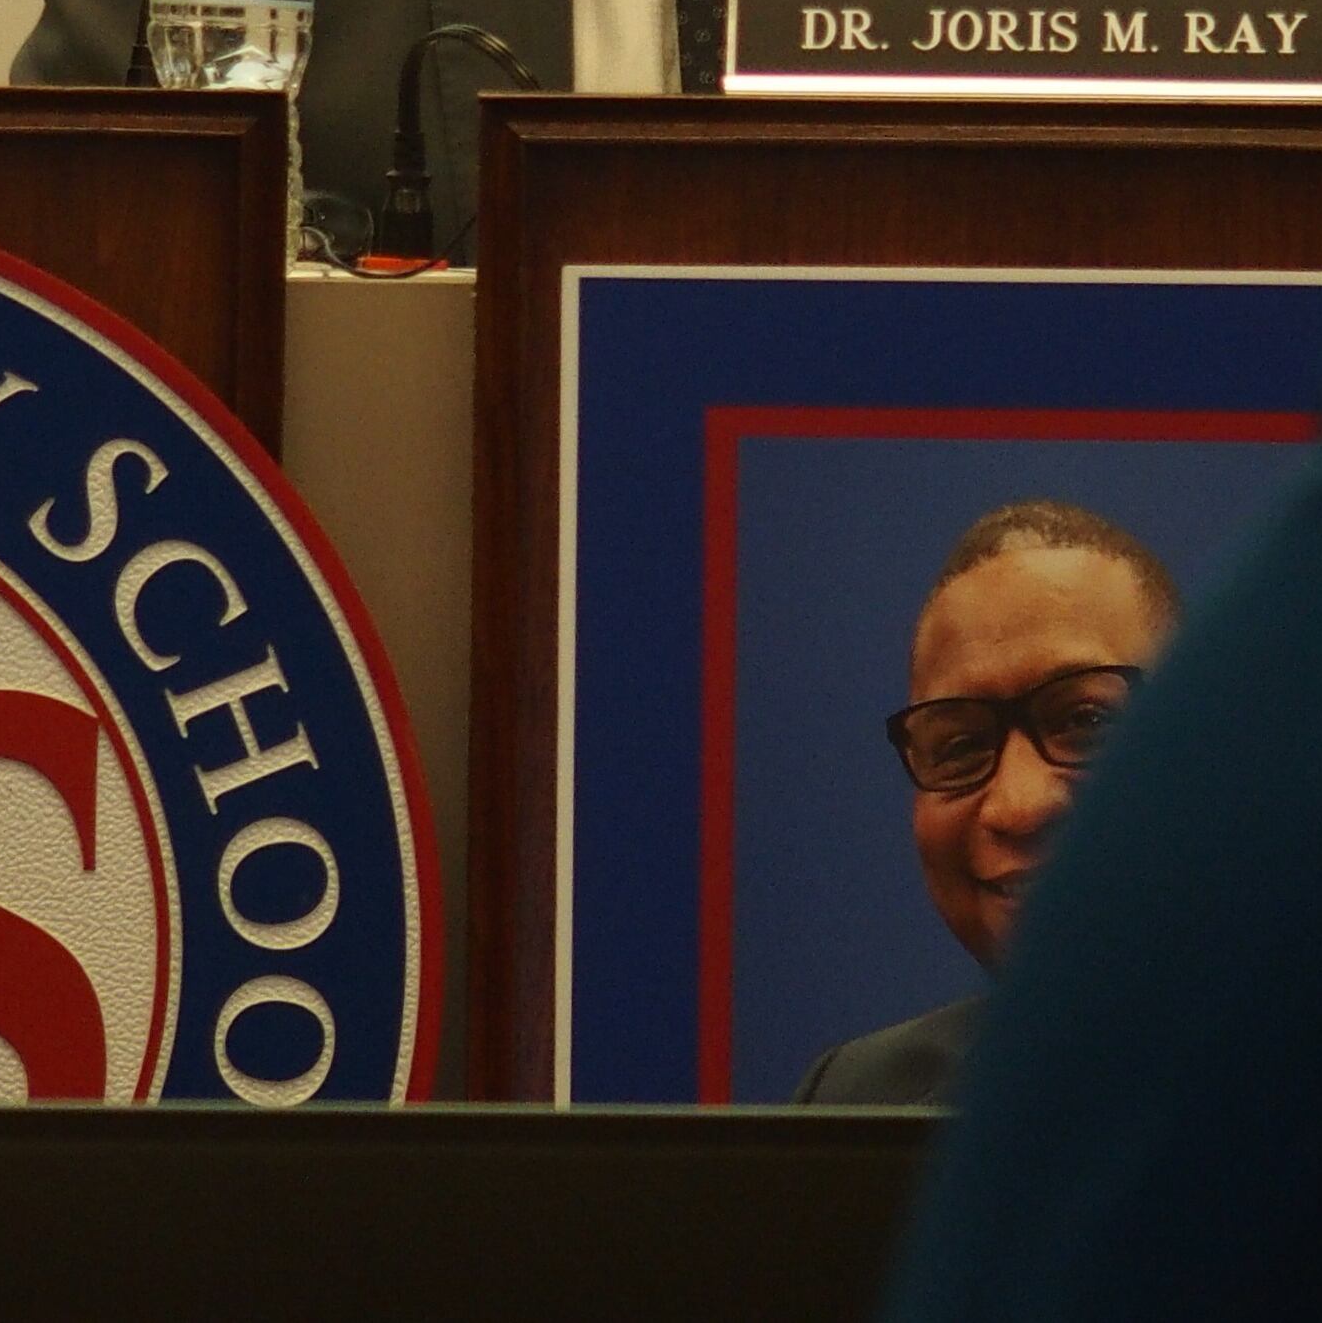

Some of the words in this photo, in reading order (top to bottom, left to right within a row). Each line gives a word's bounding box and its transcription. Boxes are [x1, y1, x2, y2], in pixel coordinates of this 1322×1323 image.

[800, 8, 889, 51] DR.
[911, 10, 1078, 53] JORIS
[1101, 11, 1159, 54] M.
[1183, 12, 1308, 55] RAY
[27, 437, 341, 1108] SCHOO
